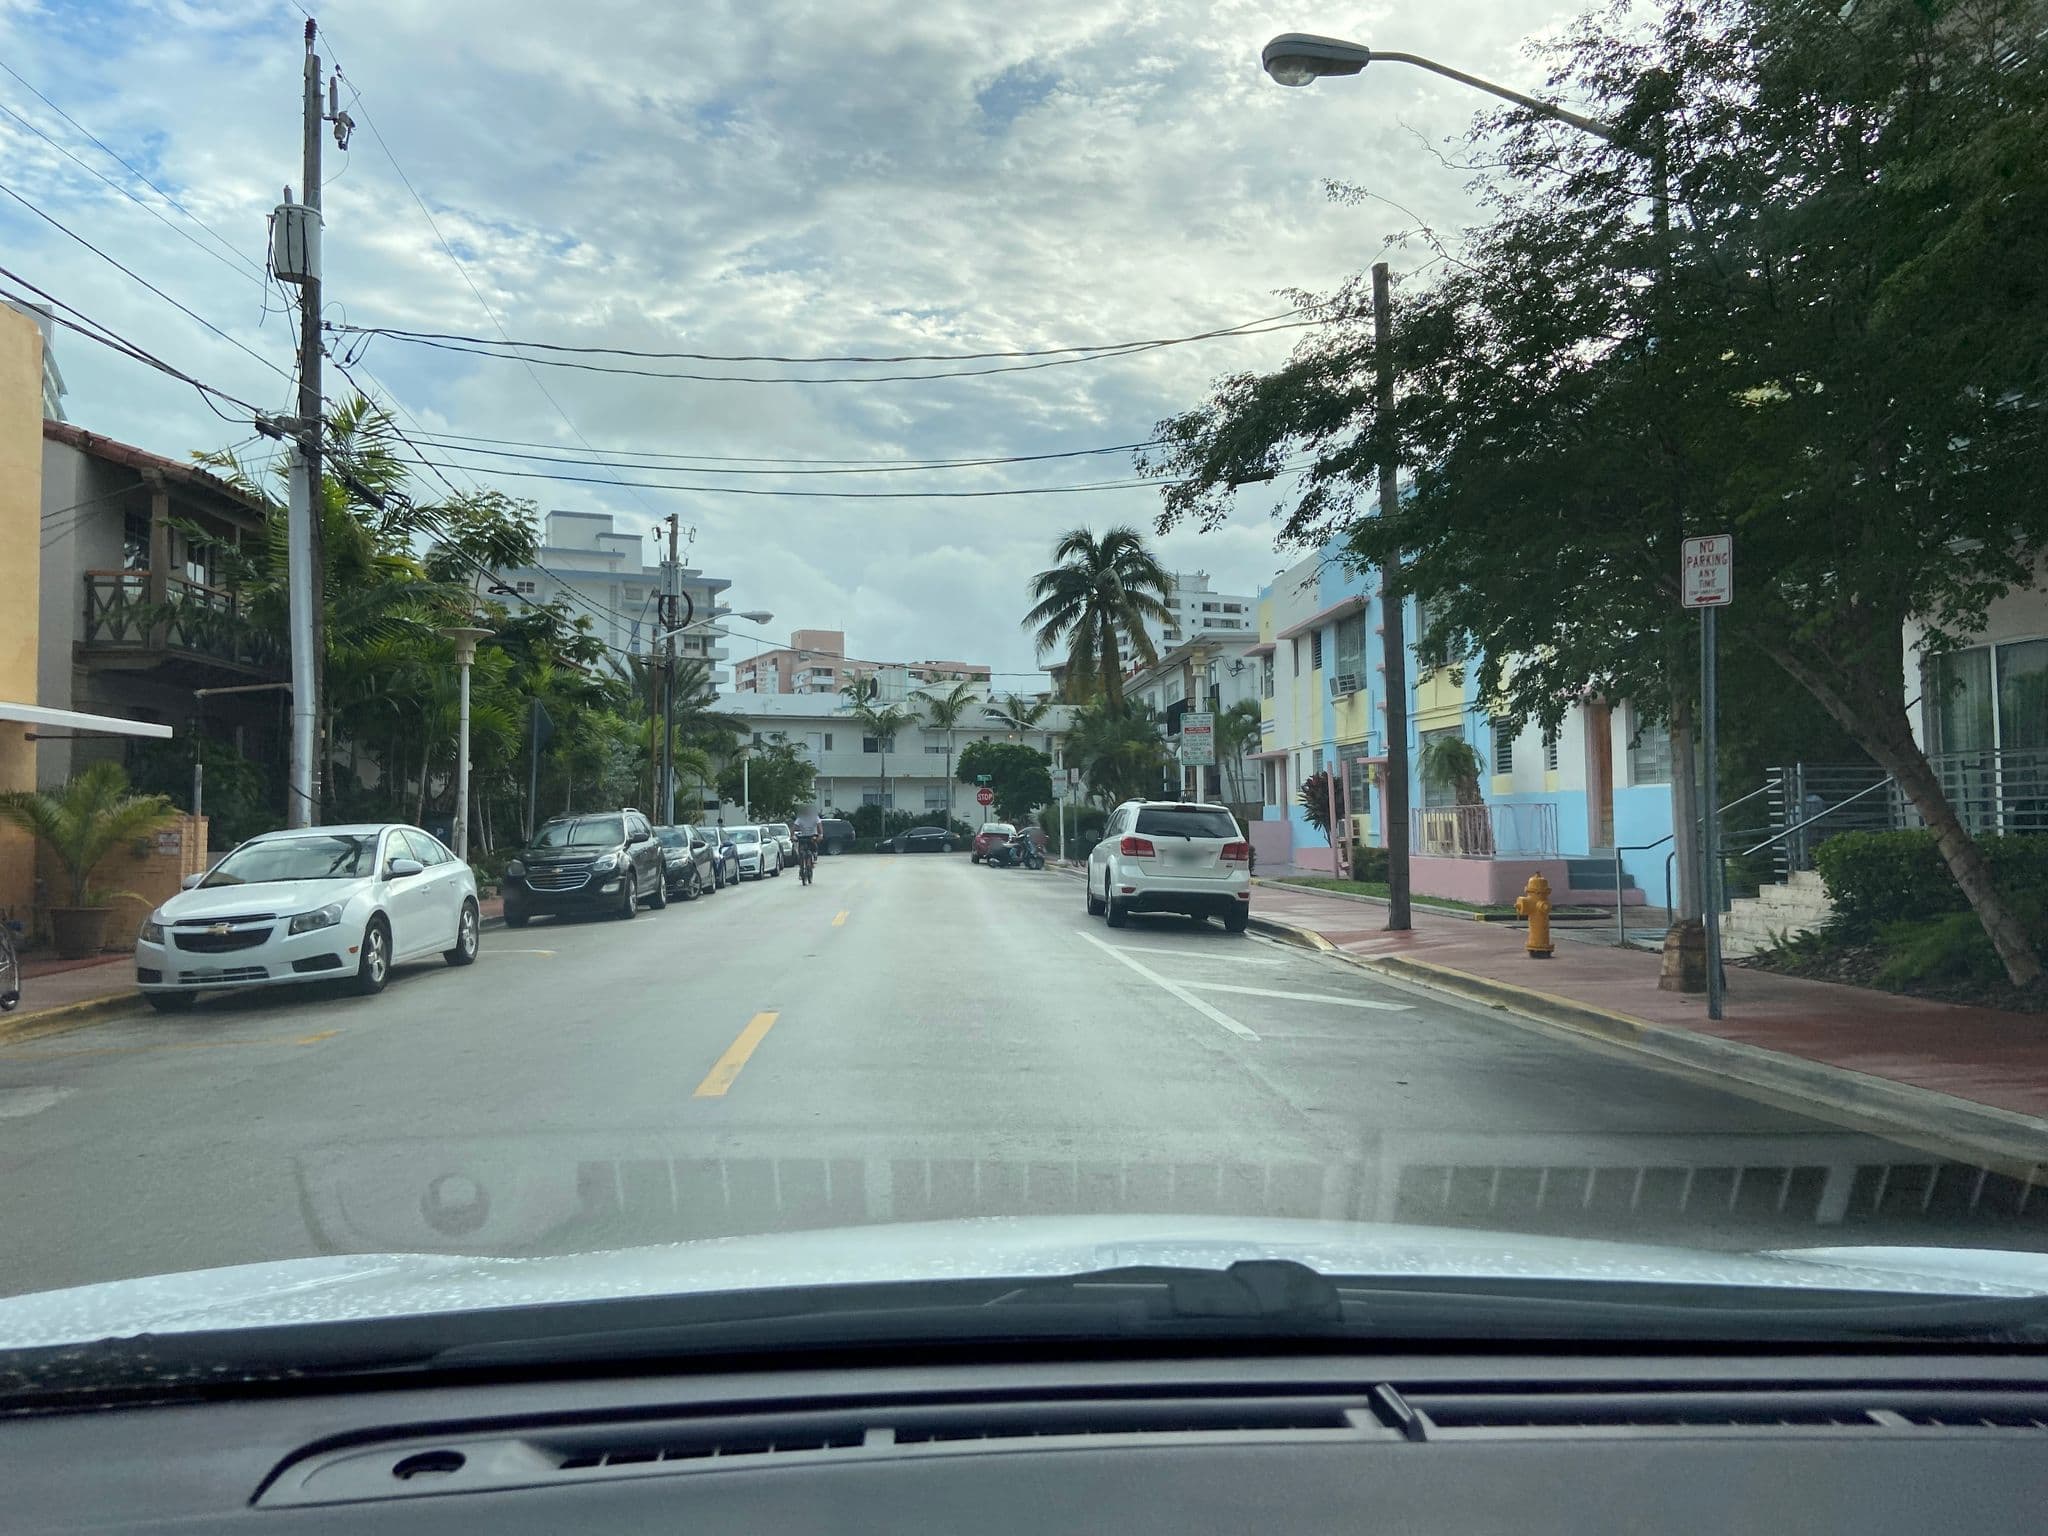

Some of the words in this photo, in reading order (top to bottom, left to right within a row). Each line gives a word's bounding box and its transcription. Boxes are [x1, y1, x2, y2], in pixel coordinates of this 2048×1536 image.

[1699, 540, 1715, 554] NO
[1686, 552, 1729, 569] PARKING
[1699, 568, 1717, 578] ANY
[1698, 578, 1717, 588] TIME
[977, 793, 993, 801] STOP
